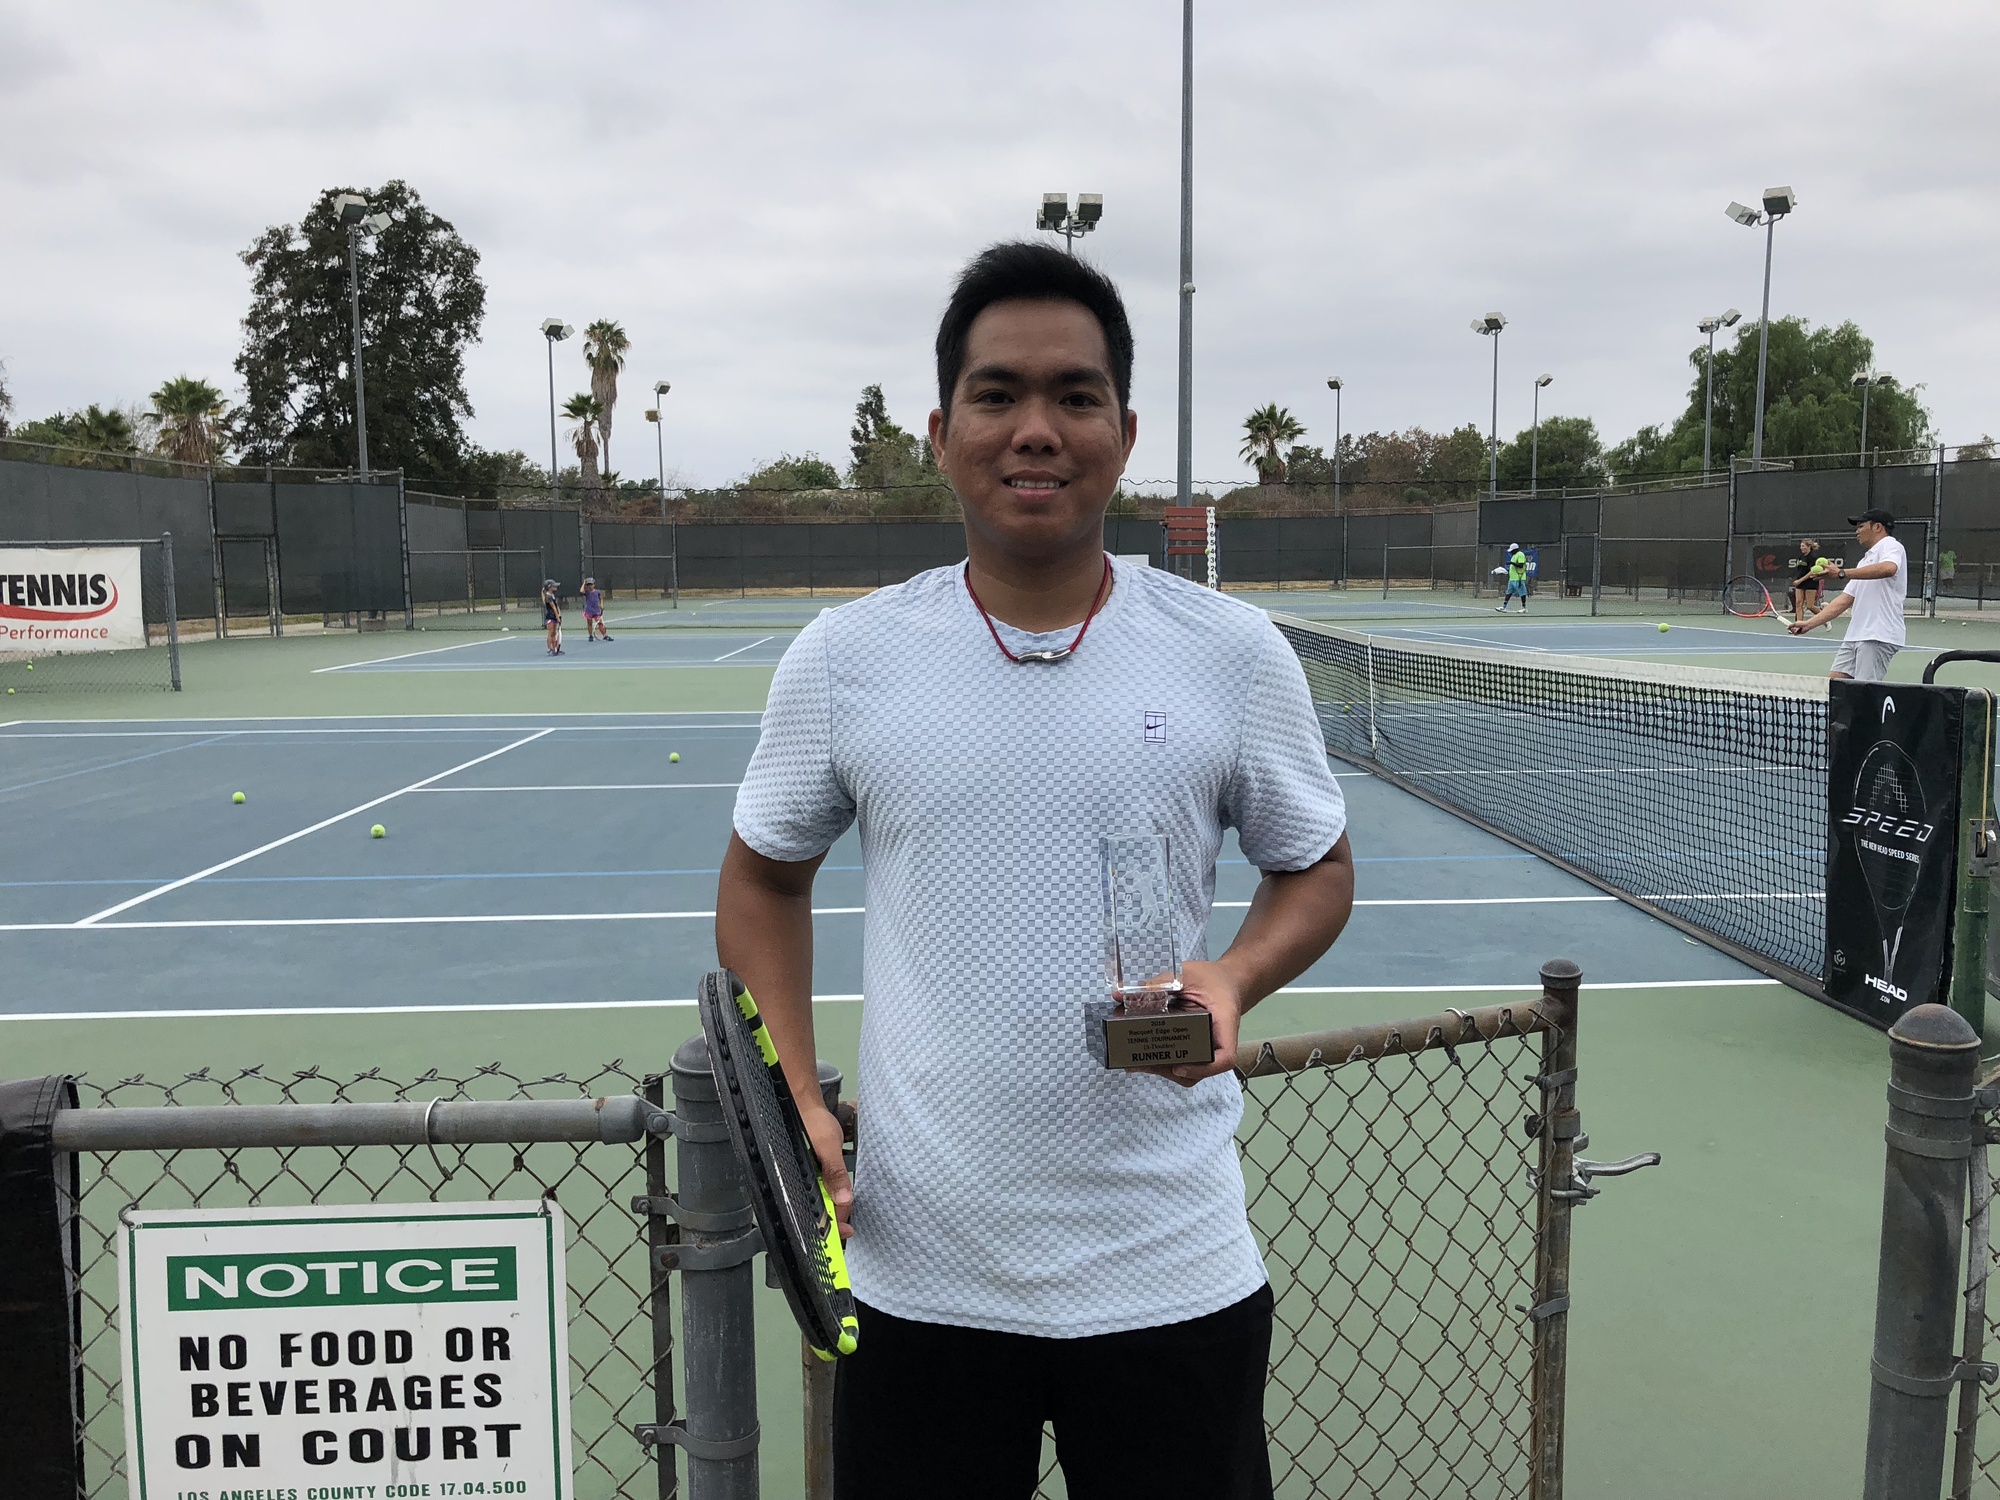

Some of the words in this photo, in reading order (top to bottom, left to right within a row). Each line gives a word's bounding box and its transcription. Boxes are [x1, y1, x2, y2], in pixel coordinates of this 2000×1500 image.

[0, 624, 108, 639] Performance
[1842, 807, 1934, 843] SPEED
[1860, 839, 1869, 849] THE
[1868, 841, 1877, 852] NEW
[1877, 844, 1888, 856] HEAD
[1888, 848, 1905, 859] SPEED
[1864, 973, 1908, 1002] HEAD
[1151, 1034, 1191, 1042] TOURNAMENT
[1132, 1051, 1171, 1062] RUNNER
[1175, 1050, 1189, 1059] UP
[185, 1258, 500, 1300] NOTICE
[179, 1334, 247, 1371] NO
[280, 1330, 413, 1368] FOOD
[445, 1327, 511, 1363] OR
[191, 1373, 502, 1418] BEVERAGES
[175, 1434, 261, 1470] ON
[302, 1424, 522, 1466] COURT
[177, 1491, 210, 1500] LOS
[220, 1488, 298, 1500] ANGELES
[307, 1486, 377, 1500] COUNTY
[385, 1484, 431, 1498] CODE
[440, 1480, 527, 1496] 17.04.500
